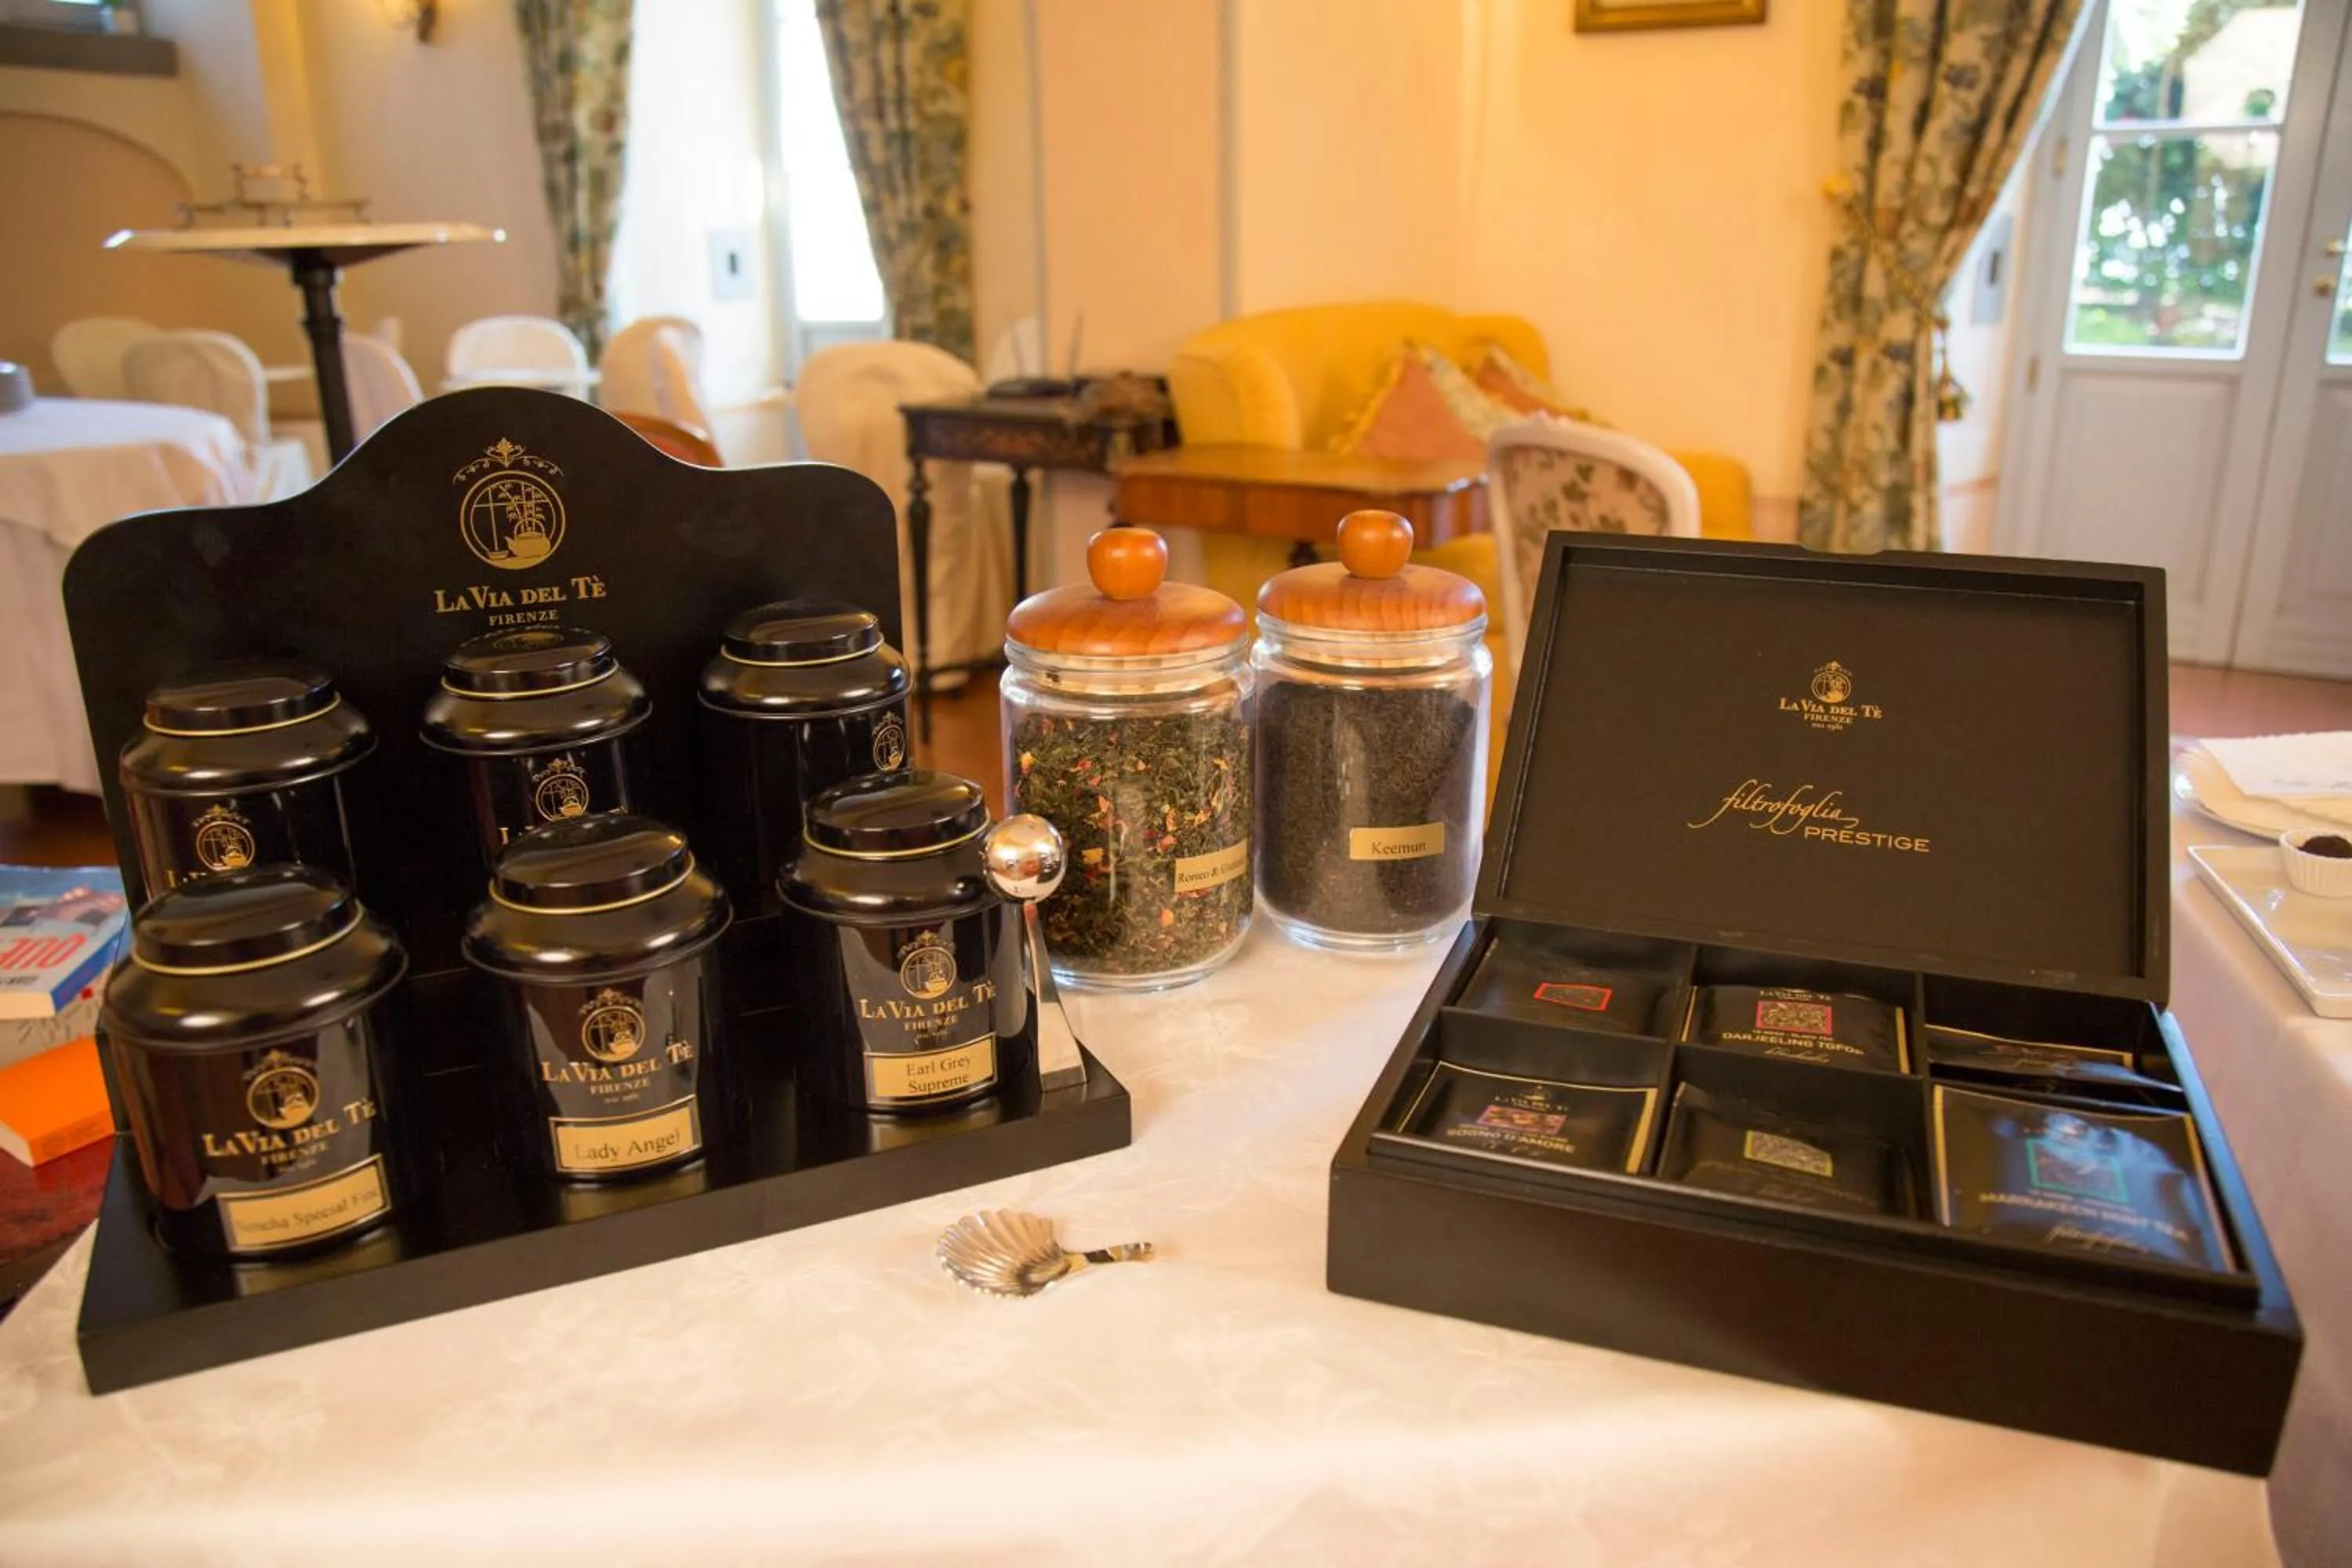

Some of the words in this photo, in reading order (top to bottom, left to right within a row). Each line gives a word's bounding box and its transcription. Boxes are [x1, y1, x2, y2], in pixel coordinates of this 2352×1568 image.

[520, 586, 567, 604] DEL
[488, 610, 560, 626] FIRENZE
[1804, 713, 1853, 724] FIRENZE
[1687, 779, 1860, 835] filtrofoglia
[1371, 841, 1427, 855] Keemun
[1804, 826, 1931, 852] PRESTIGE
[1177, 871, 1210, 884] Romeo
[932, 996, 969, 1015] DEL
[903, 1015, 958, 1032] FIRENZE
[1722, 1032, 1813, 1048] DARJEELING
[620, 1058, 662, 1078] DEL
[906, 1062, 935, 1077] Earl
[940, 1055, 972, 1073] Grey
[590, 1078, 652, 1095] FIRENZE
[908, 1073, 970, 1095] Supreme
[292, 1119, 340, 1145] DEL
[575, 1143, 620, 1163] Lady
[627, 1128, 681, 1156] Angel
